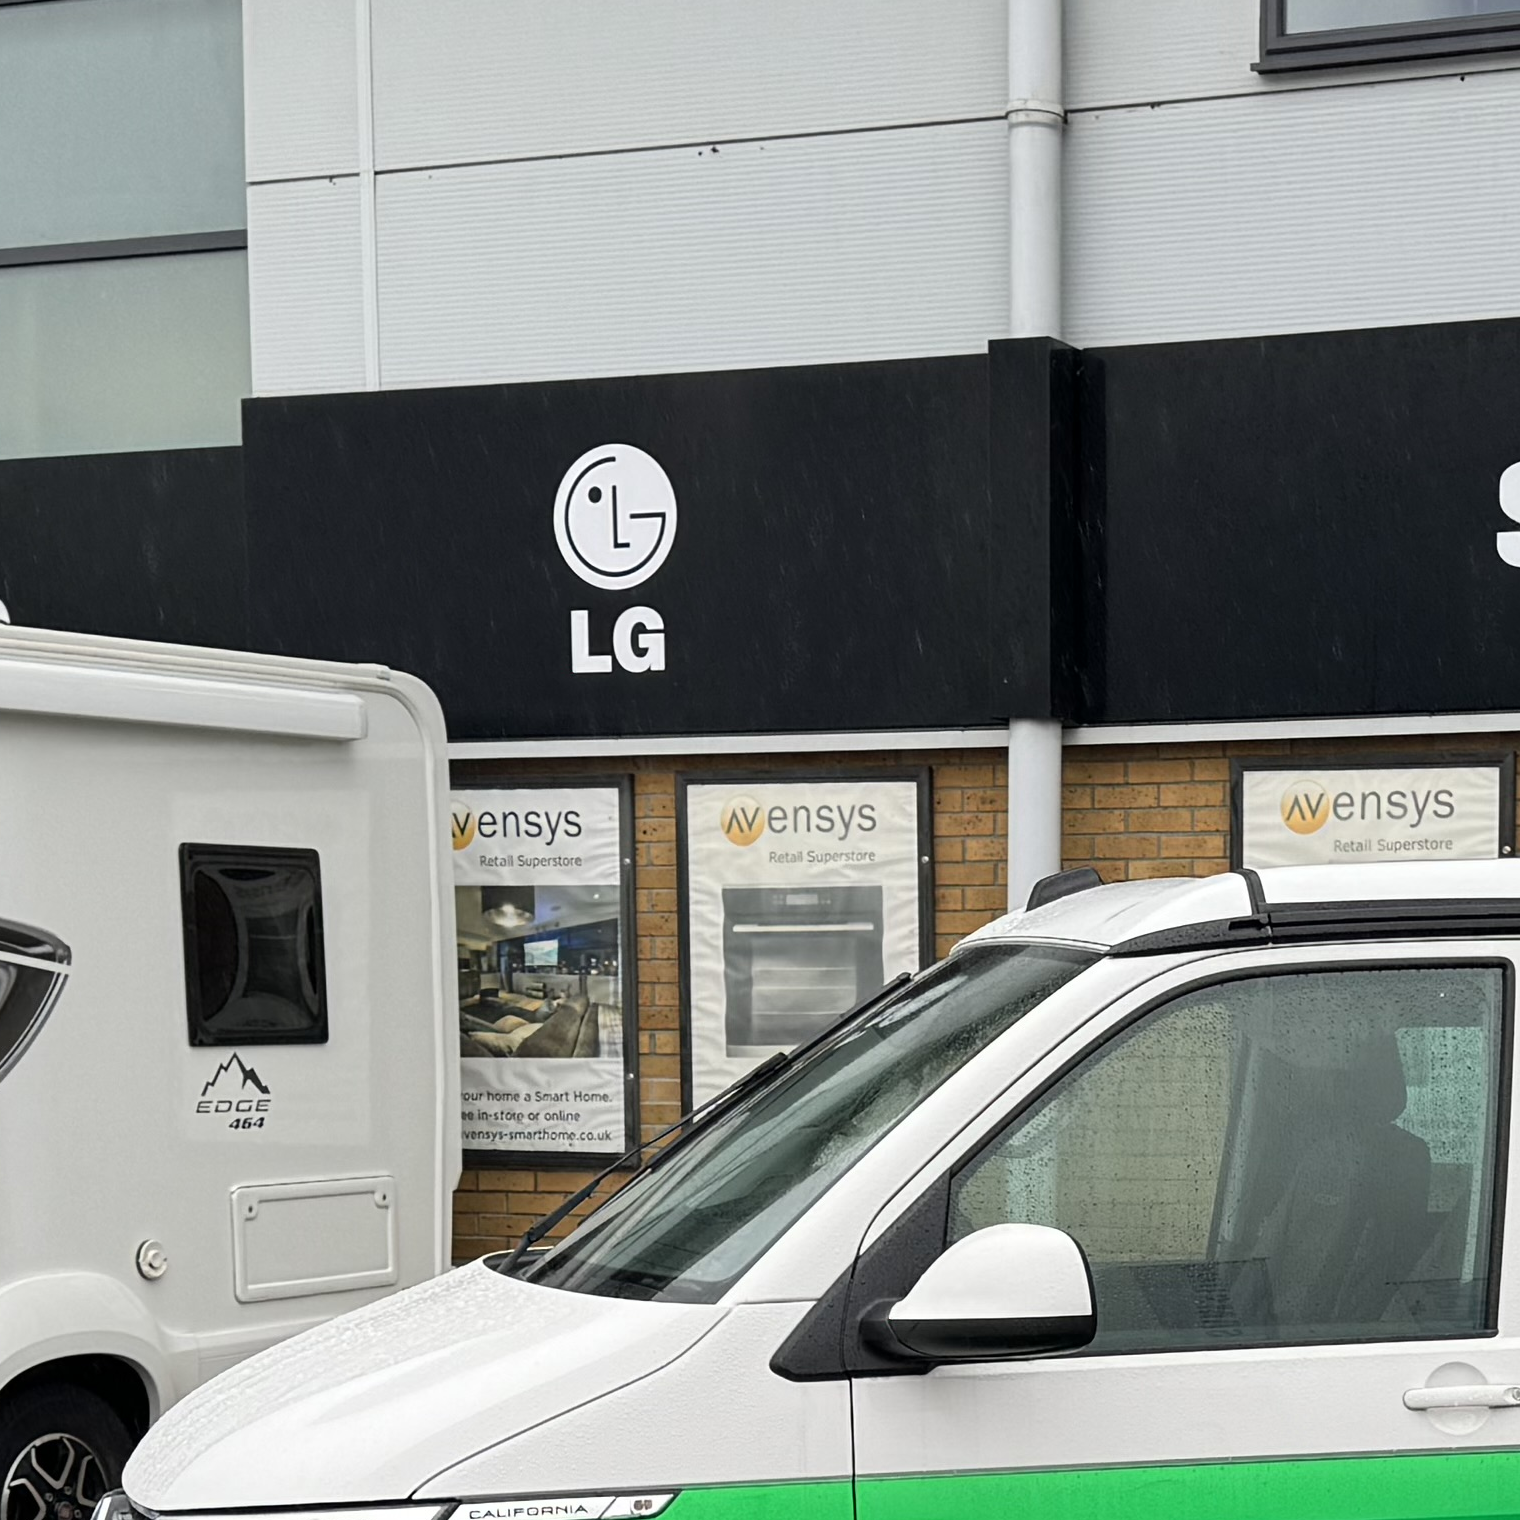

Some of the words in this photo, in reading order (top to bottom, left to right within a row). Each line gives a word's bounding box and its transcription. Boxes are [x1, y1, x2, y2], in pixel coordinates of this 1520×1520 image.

[570, 605, 666, 674] LG
[1285, 789, 1456, 828] Avensys
[452, 811, 583, 847] vensys
[725, 803, 878, 842] Avensys
[1333, 838, 1372, 853] Retail
[1377, 837, 1454, 854] Superstore
[479, 854, 514, 867] Retail
[517, 854, 583, 869] Superstore
[769, 851, 804, 864] Retail
[807, 849, 876, 865] Superstore
[486, 1090, 521, 1102] home
[523, 1093, 532, 1102] a
[535, 1090, 570, 1102] Smart
[574, 1090, 613, 1102] Home.
[196, 1099, 271, 1113] EDGE
[228, 1116, 265, 1130] 464
[477, 1109, 525, 1121] in-store
[527, 1111, 540, 1121] or
[544, 1109, 581, 1121] online
[461, 1128, 612, 1143] vensys-smarthome.co.uk
[469, 1504, 588, 1520] CALIFORNIA
